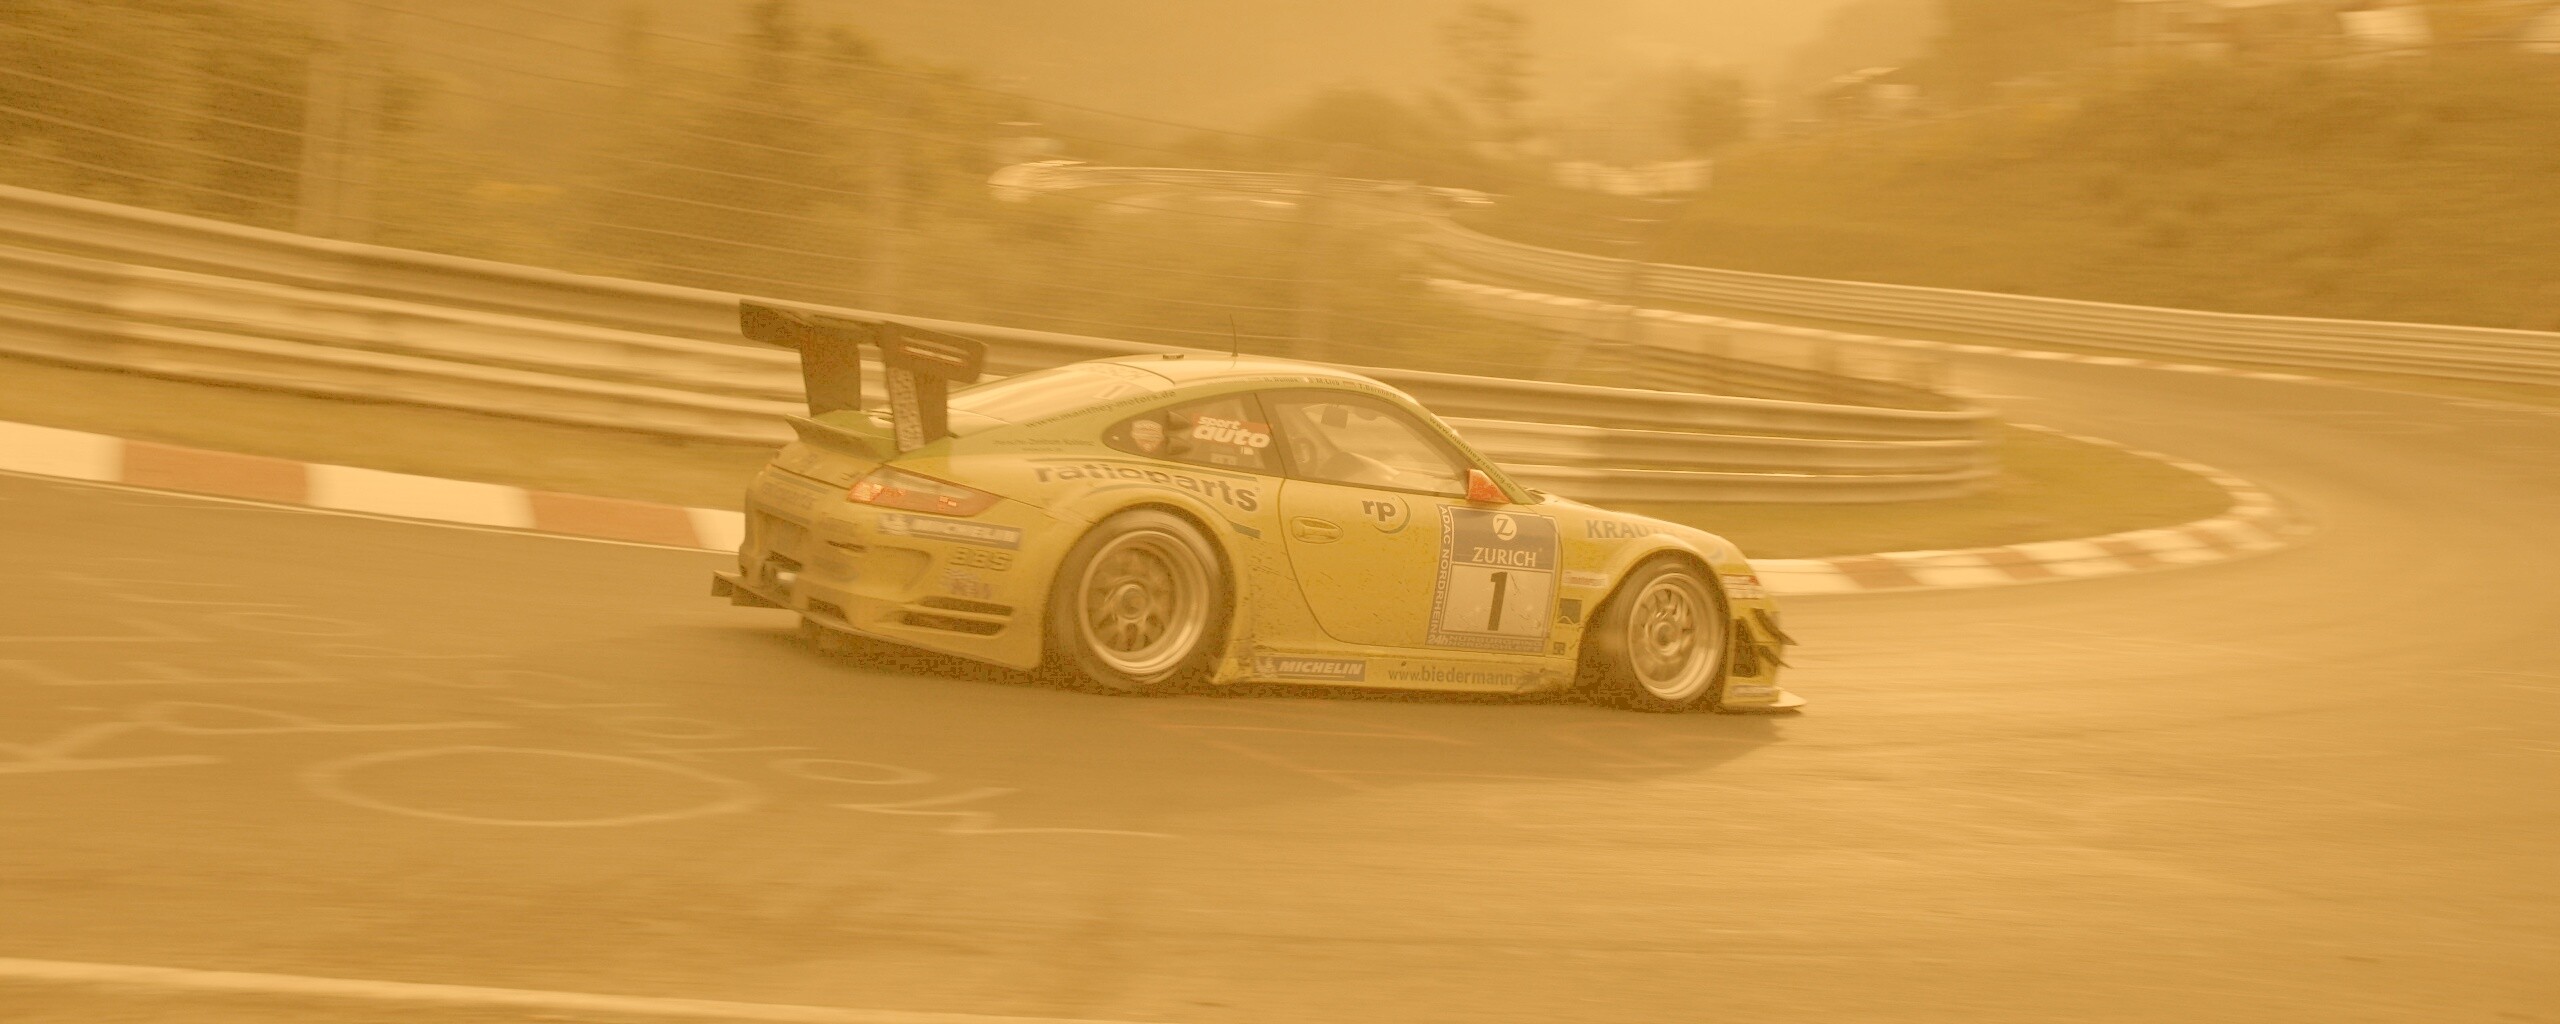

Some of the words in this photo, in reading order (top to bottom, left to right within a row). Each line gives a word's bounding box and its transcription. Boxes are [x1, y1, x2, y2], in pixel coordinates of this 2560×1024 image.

[1197, 416, 1242, 430] sport
[1192, 424, 1271, 449] auto
[1032, 463, 1258, 513] ratioparts
[1361, 499, 1396, 522] rp
[1438, 505, 1451, 544] ADAC
[1471, 546, 1537, 568] ZURICH
[1428, 549, 1451, 633] NORDRHEIN
[1486, 571, 1508, 632] 1
[1278, 660, 1364, 675] MICHELIN
